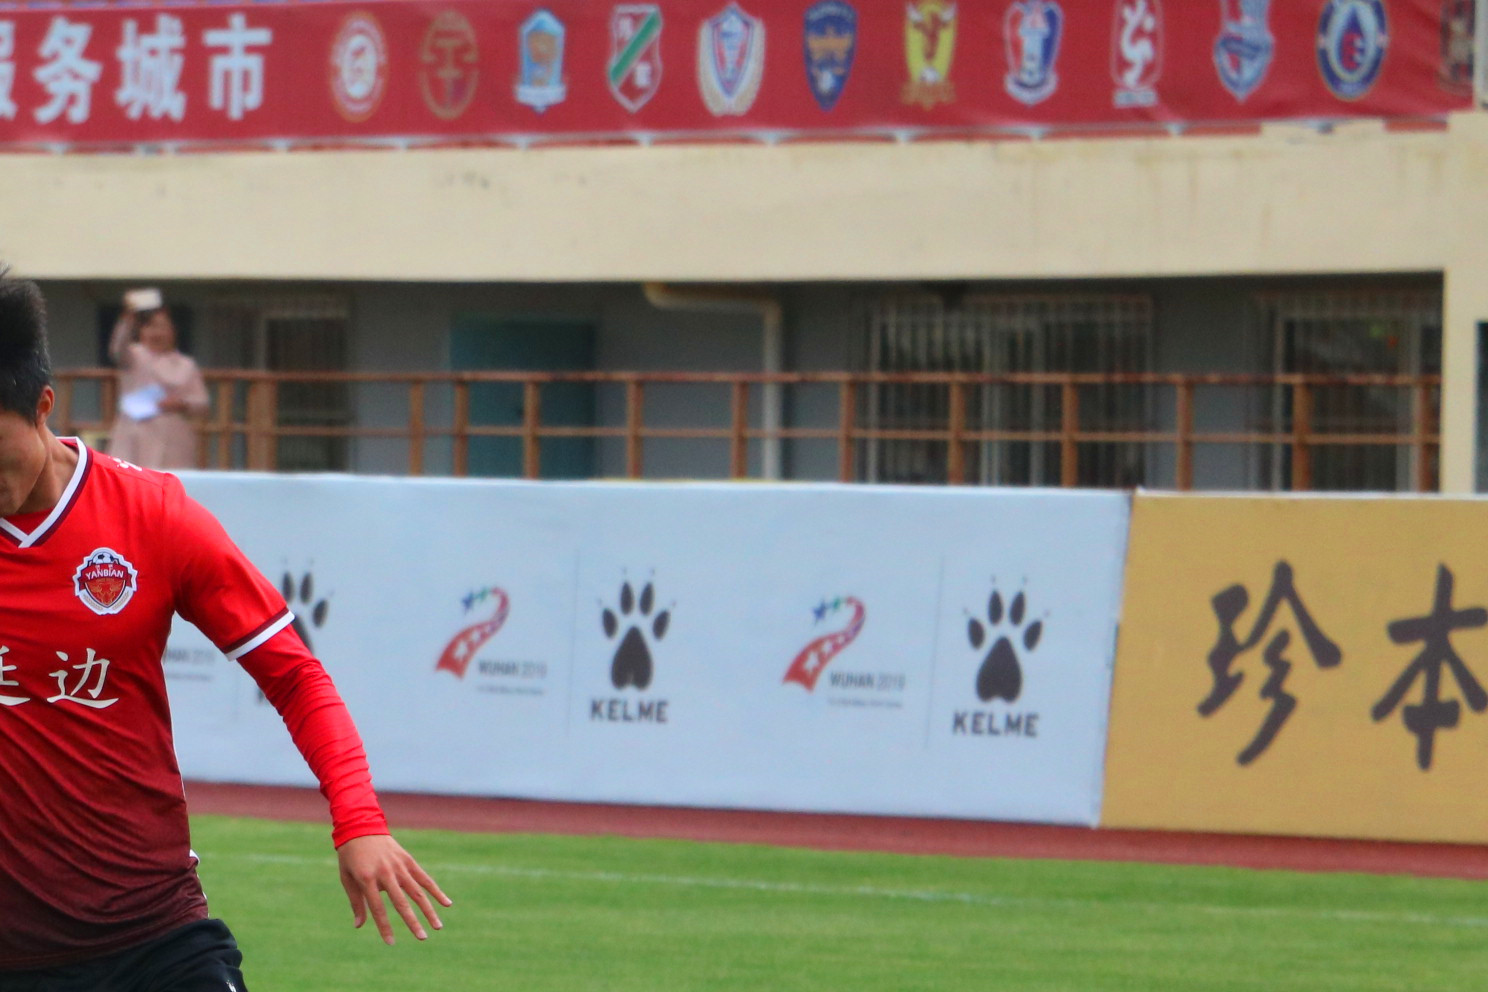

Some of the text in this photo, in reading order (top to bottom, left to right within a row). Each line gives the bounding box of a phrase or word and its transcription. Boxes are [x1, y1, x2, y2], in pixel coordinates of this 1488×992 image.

[85, 569, 125, 580] YANBIAN
[590, 698, 670, 723] KELME
[952, 710, 1040, 737] KELME
